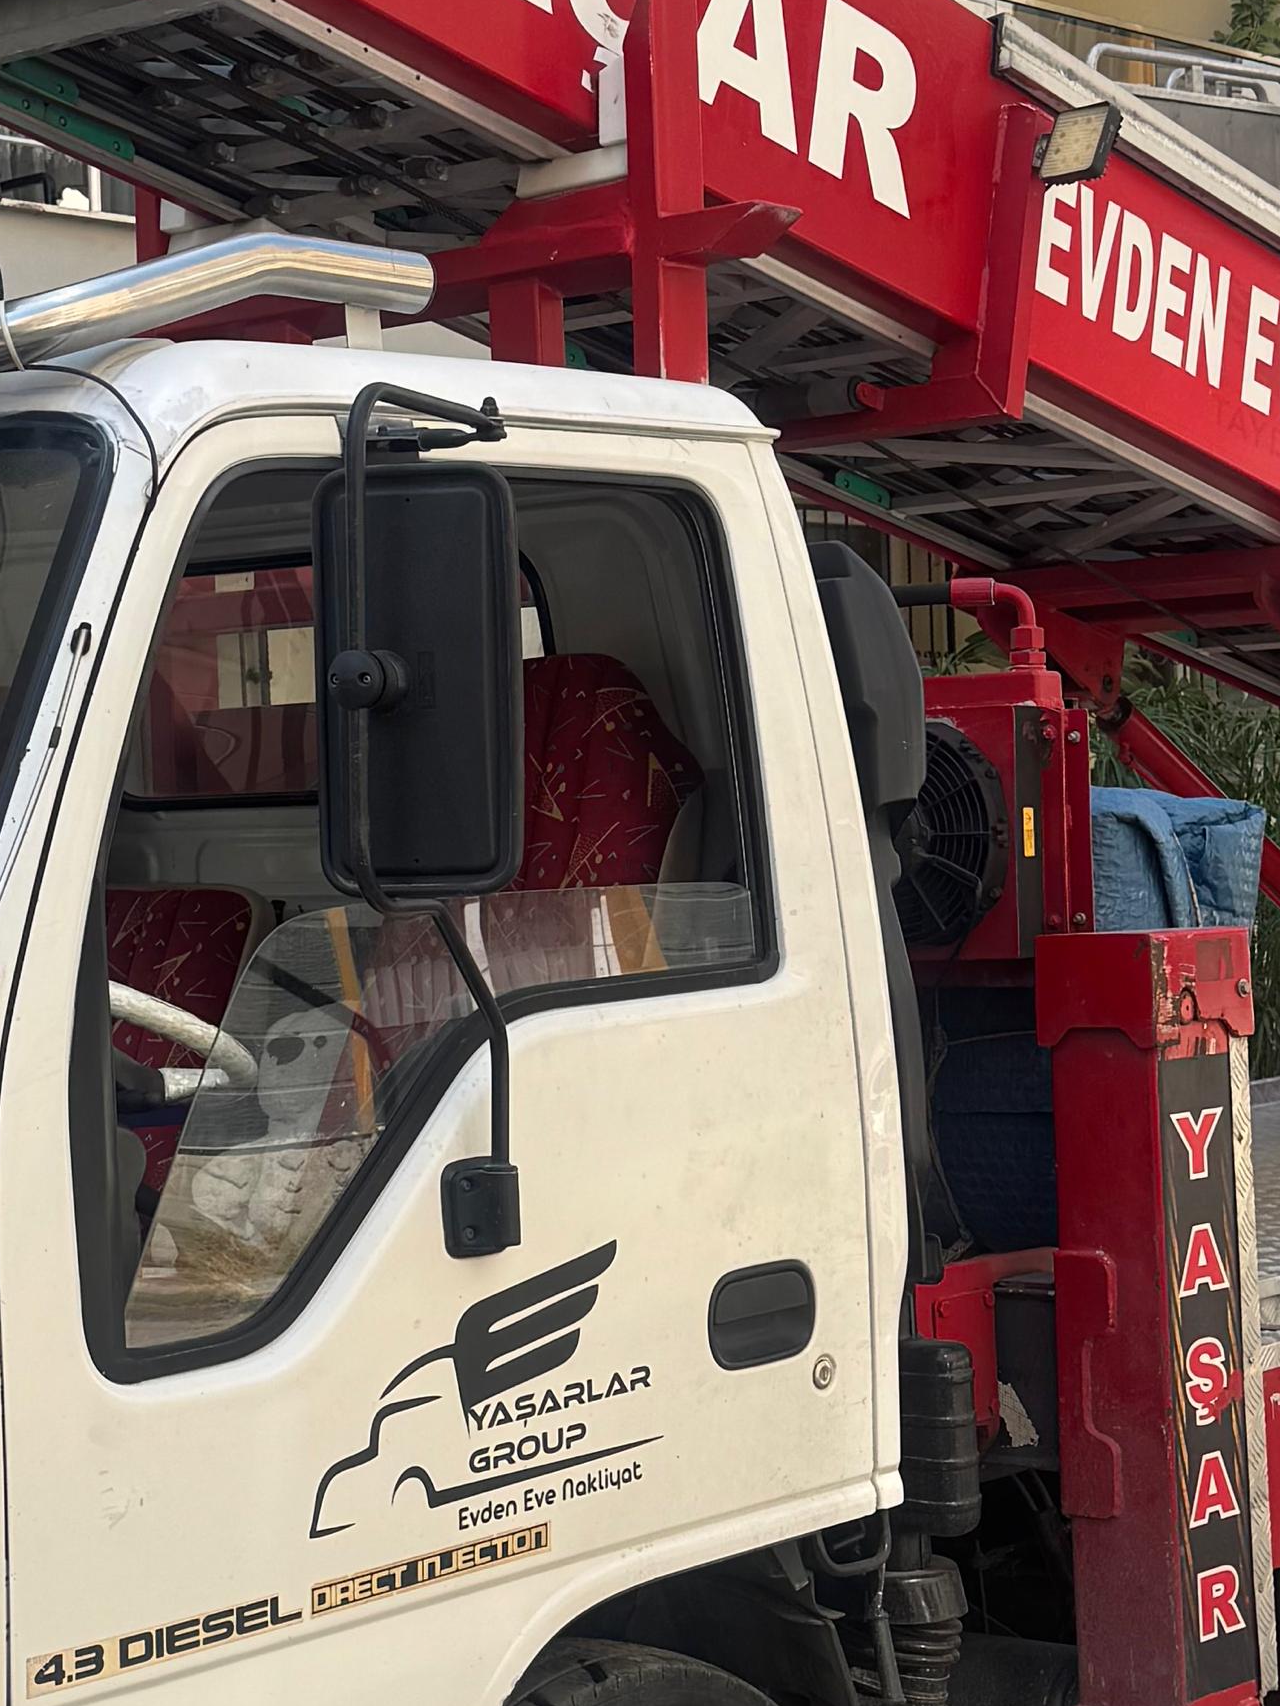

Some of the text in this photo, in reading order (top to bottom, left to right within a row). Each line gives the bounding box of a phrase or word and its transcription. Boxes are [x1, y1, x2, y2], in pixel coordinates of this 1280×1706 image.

[1034, 182, 1232, 389] EVDEN
[469, 1365, 651, 1431] YAŞARLAR
[469, 1422, 587, 1474] GROUP
[458, 1461, 643, 1530] Evden Eve Nakliyat
[313, 1525, 549, 1611] DIRECT INJECTION
[34, 1595, 303, 1686] 4.3 DIESEL
